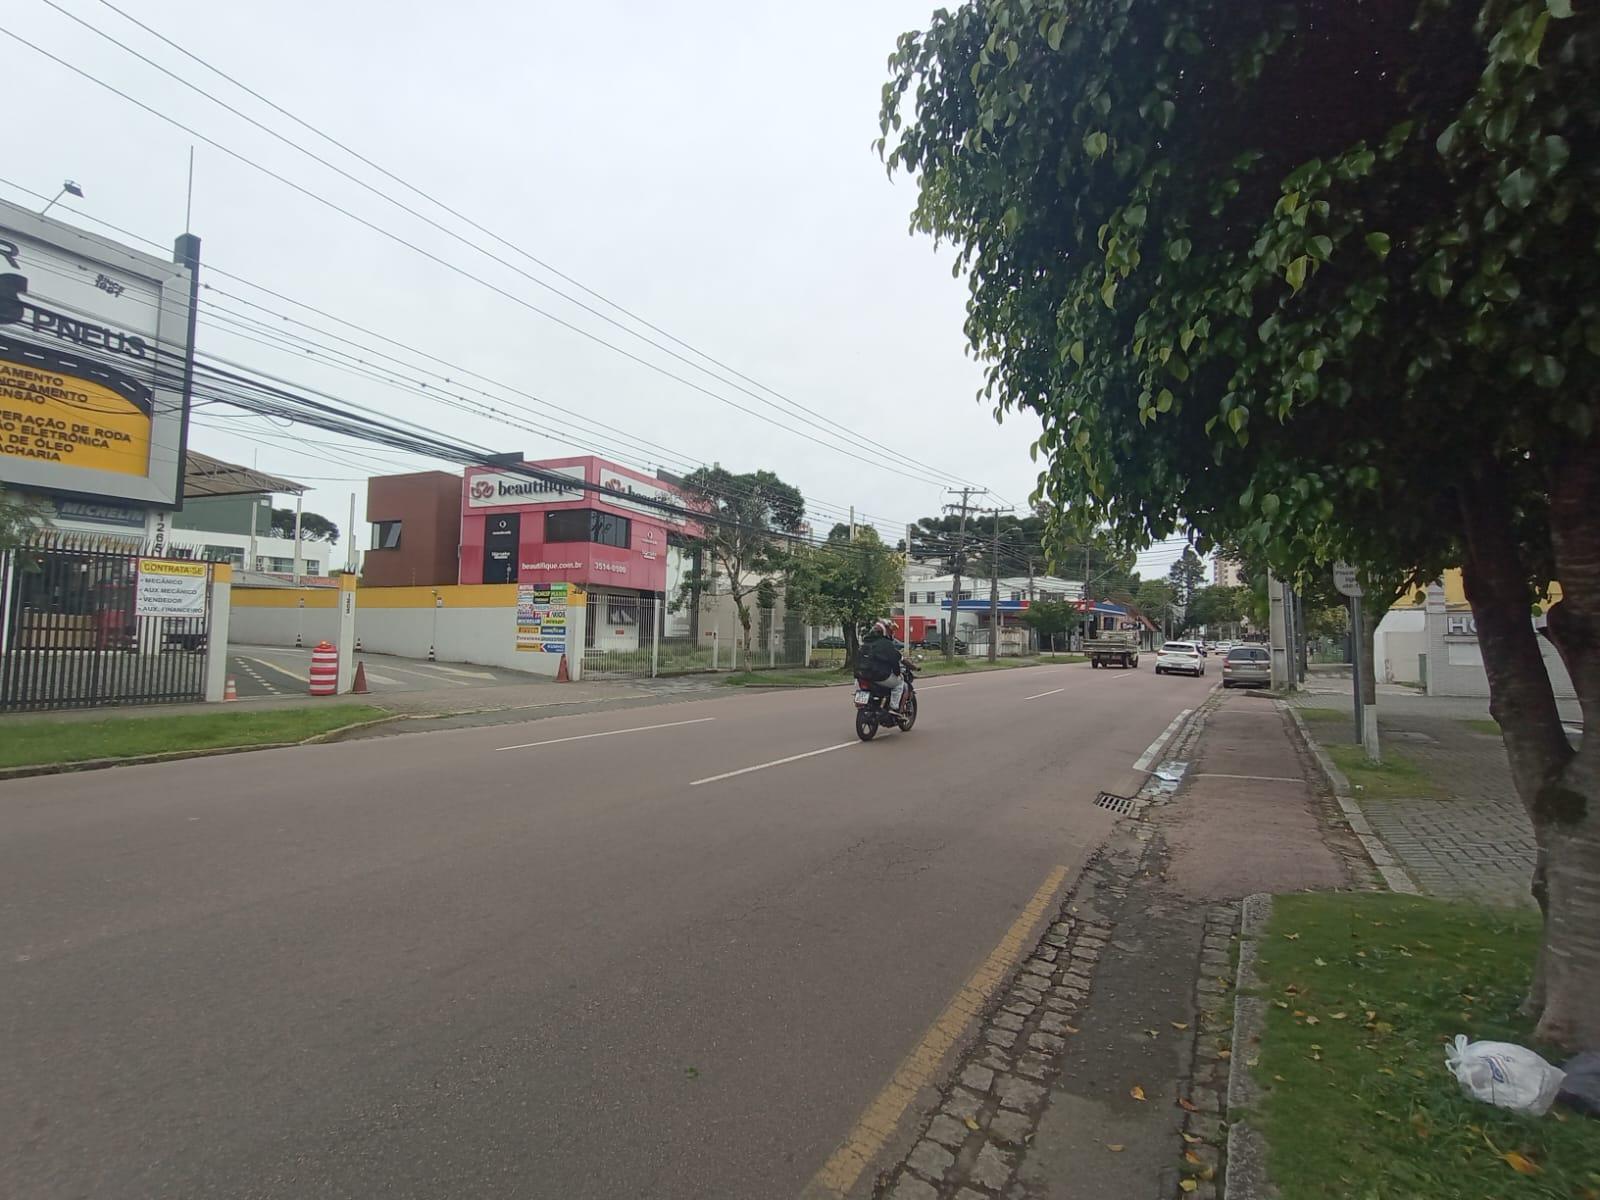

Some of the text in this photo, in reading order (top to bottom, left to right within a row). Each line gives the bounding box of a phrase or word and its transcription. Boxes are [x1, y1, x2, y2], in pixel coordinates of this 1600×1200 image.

[33, 306, 146, 357] PNEUS
[0, 410, 132, 443] ERAÇÃO DE RODA
[21, 424, 110, 448] ELETRÔNICA
[9, 434, 74, 453] DE ÓLEO
[62, 502, 144, 522] MICHELIN
[155, 512, 165, 553] 1265
[143, 563, 204, 575] CONTRATA-SE
[521, 561, 582, 571] beautifique.com.br
